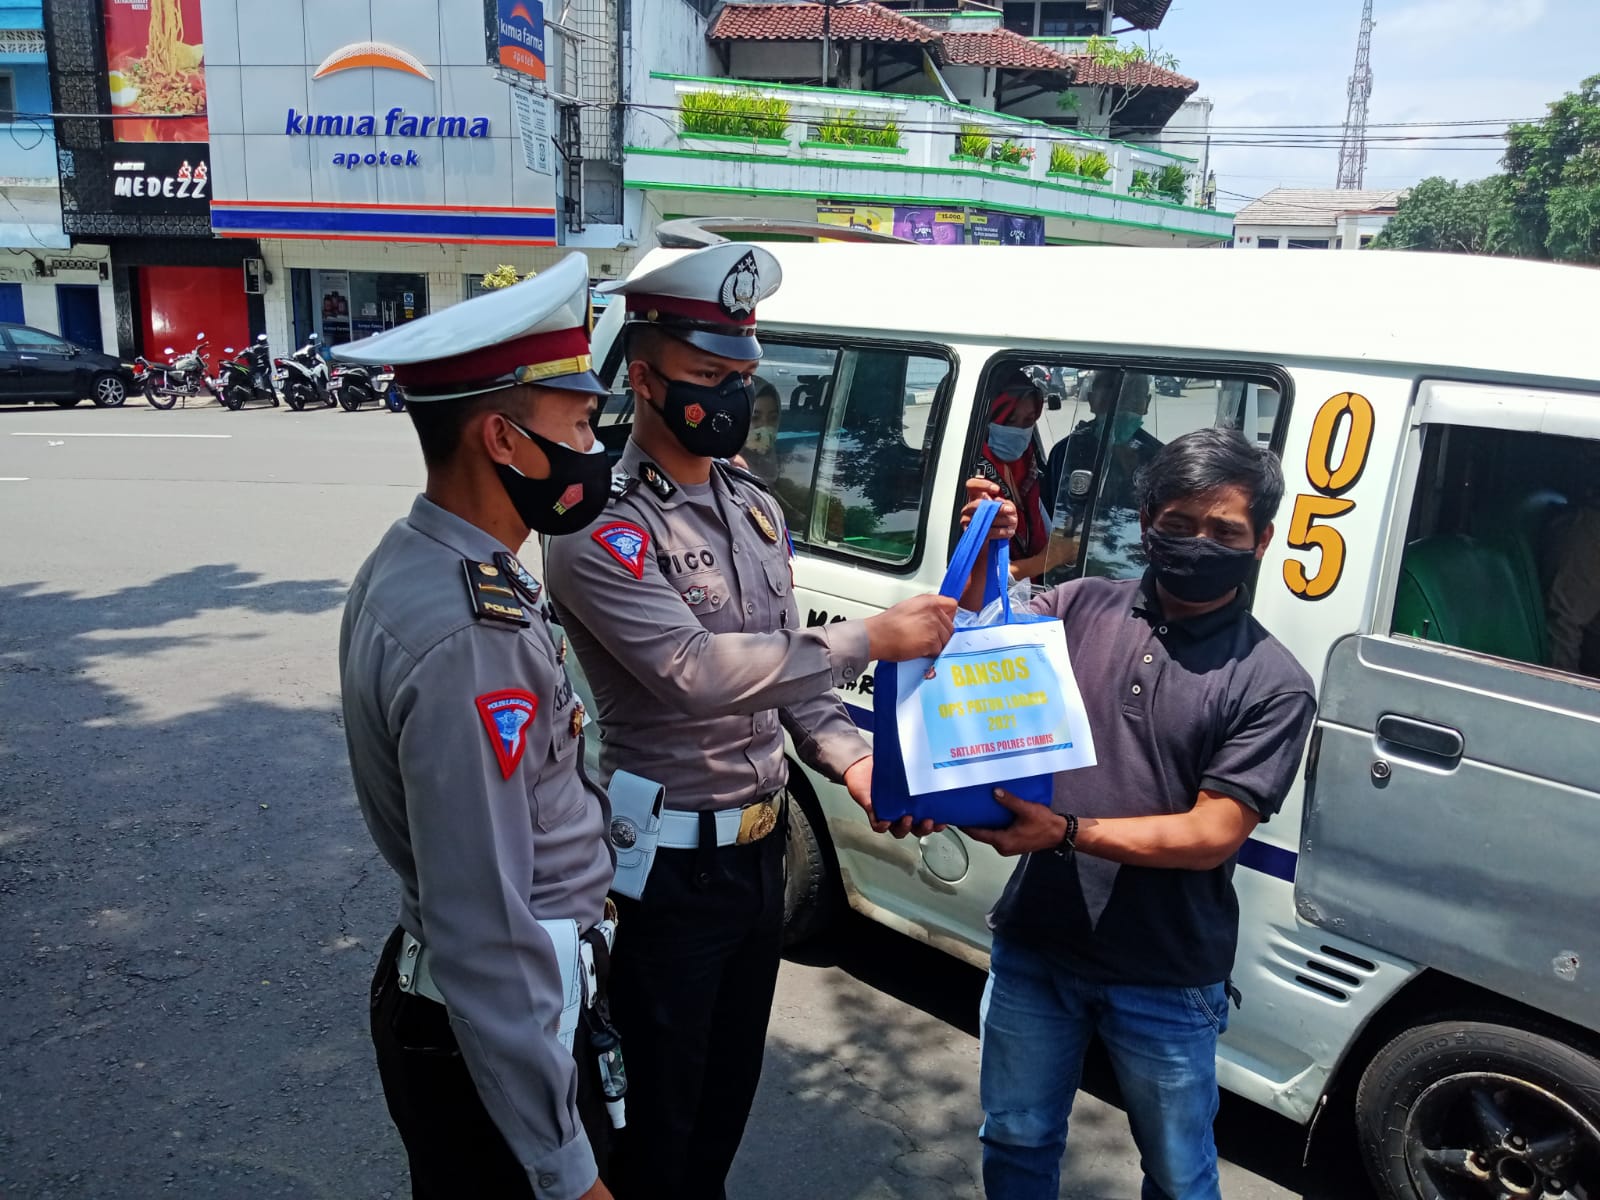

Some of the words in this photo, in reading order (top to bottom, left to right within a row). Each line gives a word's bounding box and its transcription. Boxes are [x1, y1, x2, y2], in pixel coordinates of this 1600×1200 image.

[523, 27, 543, 51] farma
[513, 51, 534, 67] apotek
[385, 107, 490, 137] farma
[332, 150, 419, 169] apotek
[114, 176, 207, 199] MEDEZZ
[553, 501, 567, 516] TNI
[483, 602, 524, 617] POLISI
[951, 656, 1031, 688] BANSOS
[938, 700, 965, 719] OPS
[987, 713, 1018, 732] 2021
[950, 741, 997, 759] SATLANTAS
[996, 737, 1026, 752] POLRES
[1026, 733, 1055, 747] CIAMIS
[1379, 1038, 1450, 1090] CHAMPIRO
